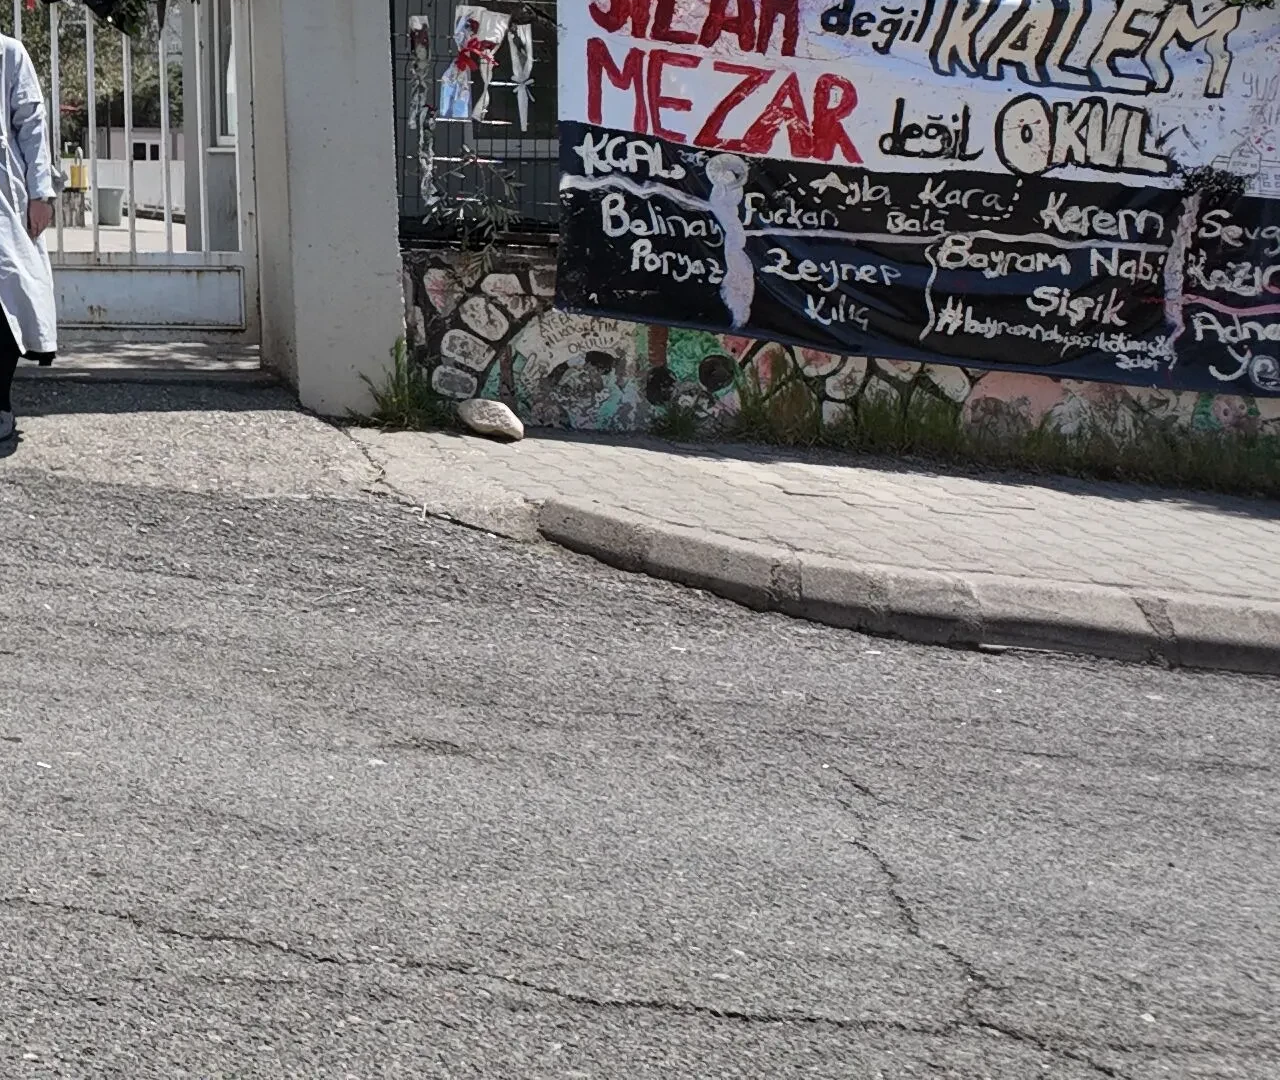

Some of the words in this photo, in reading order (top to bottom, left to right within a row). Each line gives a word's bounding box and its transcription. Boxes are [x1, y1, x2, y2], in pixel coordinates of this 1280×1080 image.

[587, 36, 864, 164] MEZAR
[878, 97, 984, 161] değil
[994, 91, 1178, 177] OKUL
[1040, 191, 1164, 240] Kerem
[760, 247, 902, 293] Zeynep
[938, 233, 1072, 279] Bayram
[1089, 248, 1164, 284] Nabi
